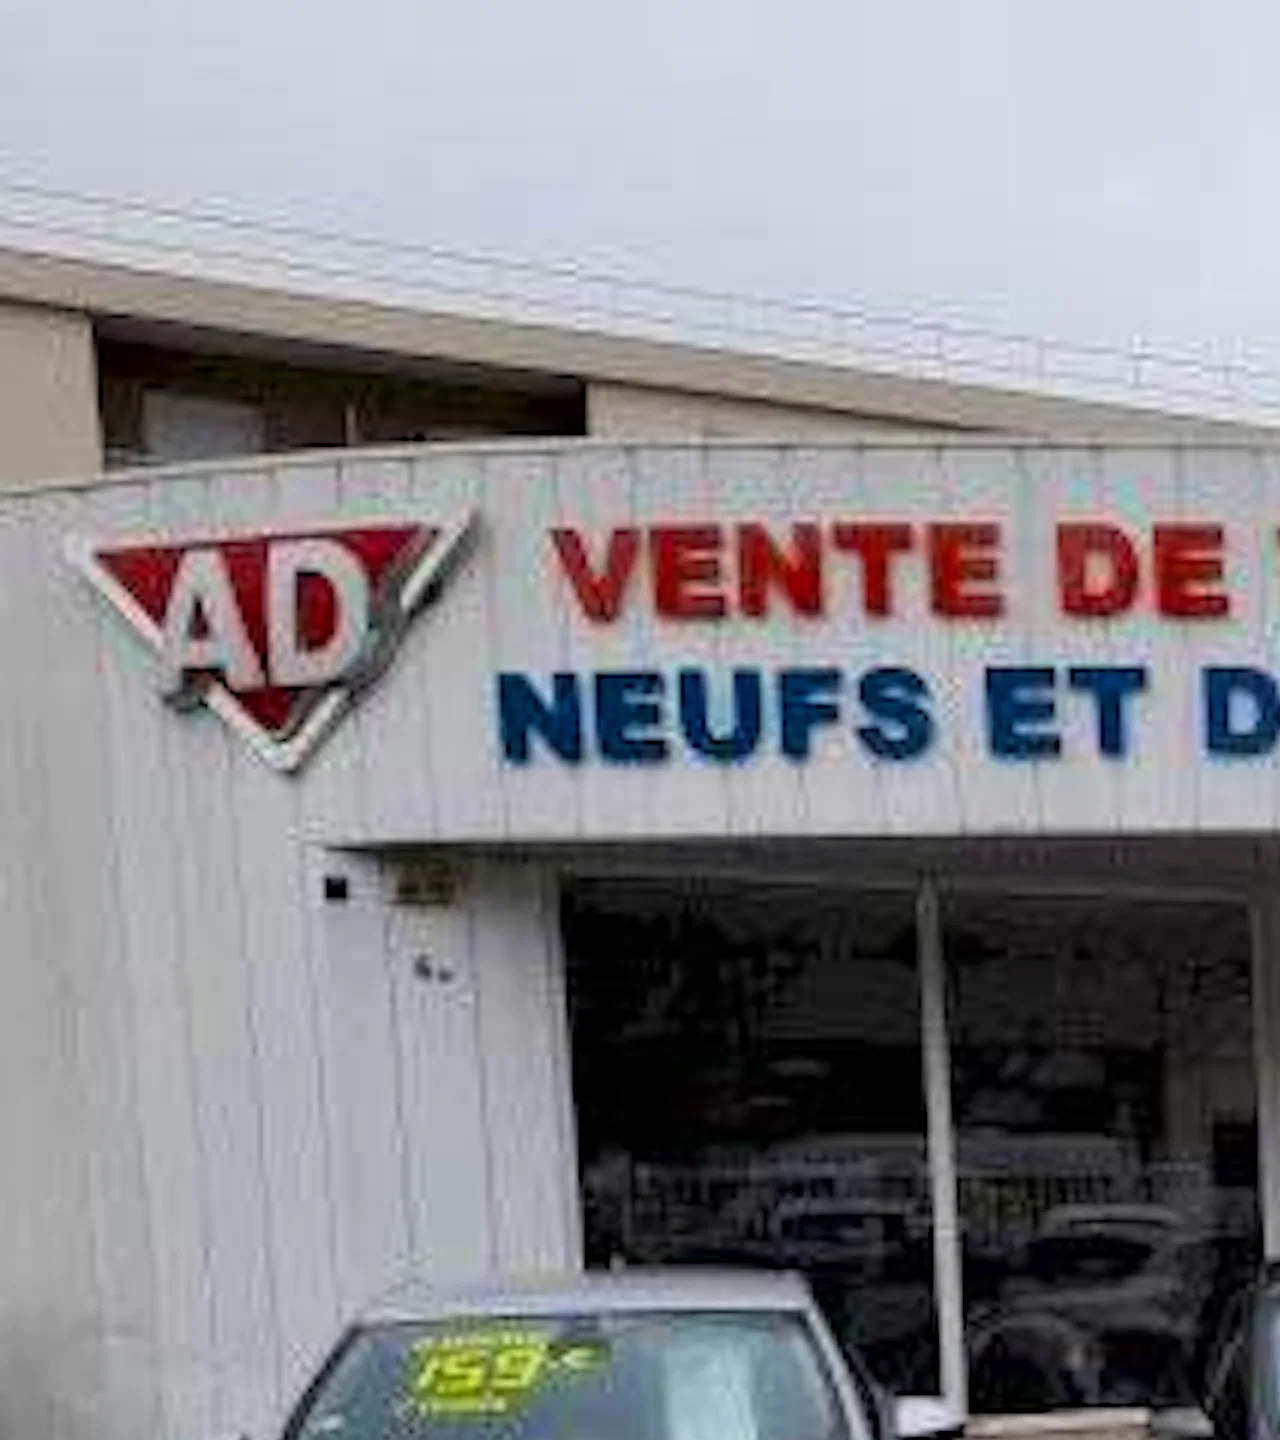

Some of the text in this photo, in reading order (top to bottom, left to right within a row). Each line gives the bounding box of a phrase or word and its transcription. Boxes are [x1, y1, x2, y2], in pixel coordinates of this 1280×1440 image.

[155, 536, 374, 690] AD
[552, 520, 1003, 624] VENTE
[1055, 519, 1232, 620] DE
[497, 664, 935, 768] NEUFS
[984, 664, 1147, 764] ET
